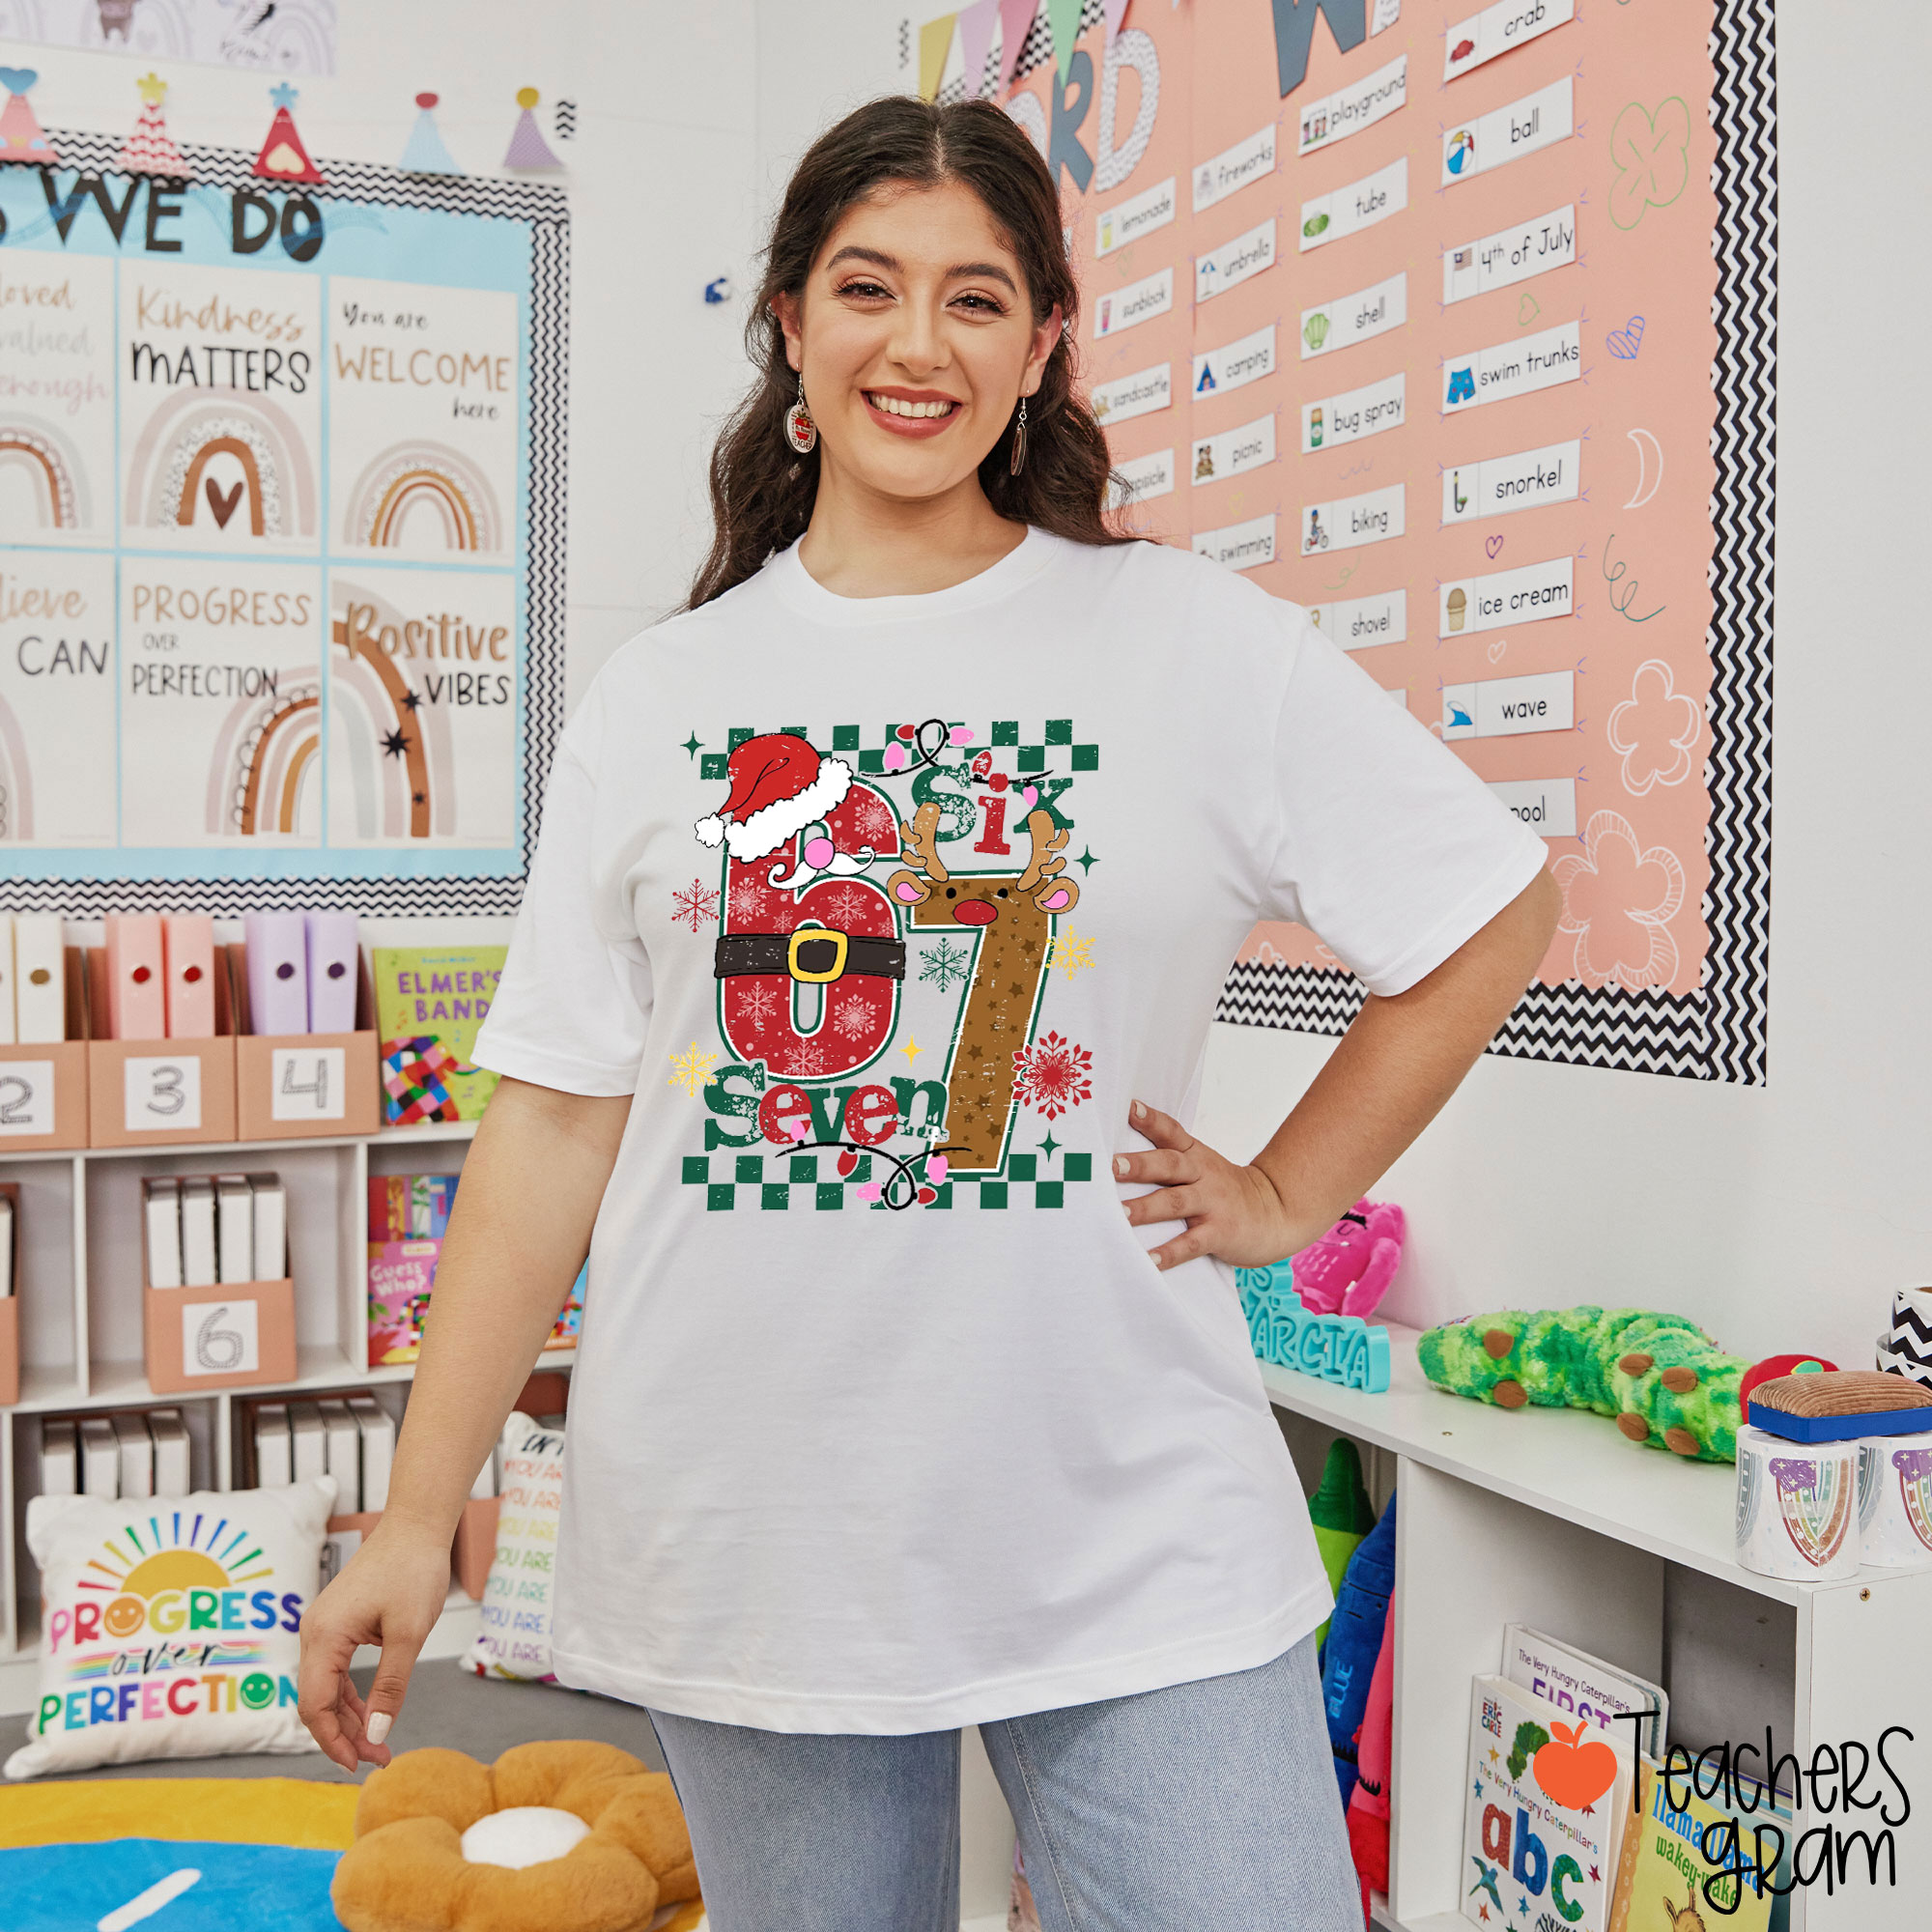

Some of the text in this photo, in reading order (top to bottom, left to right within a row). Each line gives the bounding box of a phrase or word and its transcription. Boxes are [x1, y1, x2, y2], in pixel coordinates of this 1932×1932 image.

[1504, 0, 1546, 36] crab
[1330, 64, 1406, 131] playground
[1511, 106, 1540, 143] ball
[1218, 143, 1273, 186] fireworks
[40, 171, 187, 253] WE
[232, 192, 324, 263] DO
[1121, 193, 1172, 233] lemonade
[1356, 189, 1387, 217] tube
[1224, 238, 1270, 278] umbrella
[1511, 235, 1531, 267] of
[1537, 222, 1574, 257] July
[136, 285, 304, 341] Kindness
[342, 301, 429, 330] You are
[1356, 296, 1386, 329] shell
[334, 341, 511, 391] WELCOME
[1225, 347, 1270, 380] camping
[1480, 339, 1580, 386] swim trunks
[452, 396, 499, 420] here
[1334, 397, 1404, 433] bug spray
[1233, 439, 1263, 468] picnic
[1495, 458, 1563, 499] snorkel
[1351, 511, 1389, 534] biking
[1219, 532, 1272, 563] swimming
[131, 584, 312, 626] PROGRESS
[1479, 582, 1569, 617] ice cream
[346, 602, 510, 661] Positive
[1350, 606, 1391, 637] shovel
[17, 635, 109, 676] CAN
[143, 632, 180, 652] OVER
[131, 664, 279, 697] PERFECTION
[425, 672, 511, 706] VIBES
[1501, 696, 1548, 720] wave
[415, 999, 492, 1023] BAND
[146, 1065, 185, 1116] 3
[280, 1058, 328, 1110] 4
[703, 1063, 951, 1151] Seven
[370, 1261, 422, 1283] Guess
[375, 1274, 428, 1296] Who?
[196, 1306, 244, 1370] 6
[1244, 1304, 1371, 1388] ARCIA
[522, 1548, 554, 1574] ARE
[517, 1580, 550, 1604] ARE
[50, 1589, 303, 1655] PROGRESS
[512, 1610, 547, 1635] ARE
[109, 1641, 251, 1676] over
[511, 1641, 545, 1664] ARE
[1519, 1648, 1631, 1715] The Very Hungry Caterpillar's
[38, 1672, 299, 1736] PERFECTION
[1483, 1701, 1503, 1724] ERIC
[1482, 1715, 1501, 1738] CARLE
[1479, 1761, 1598, 1855] The Very Hungry Caterpillar's
[1482, 1803, 1584, 1922] abc
